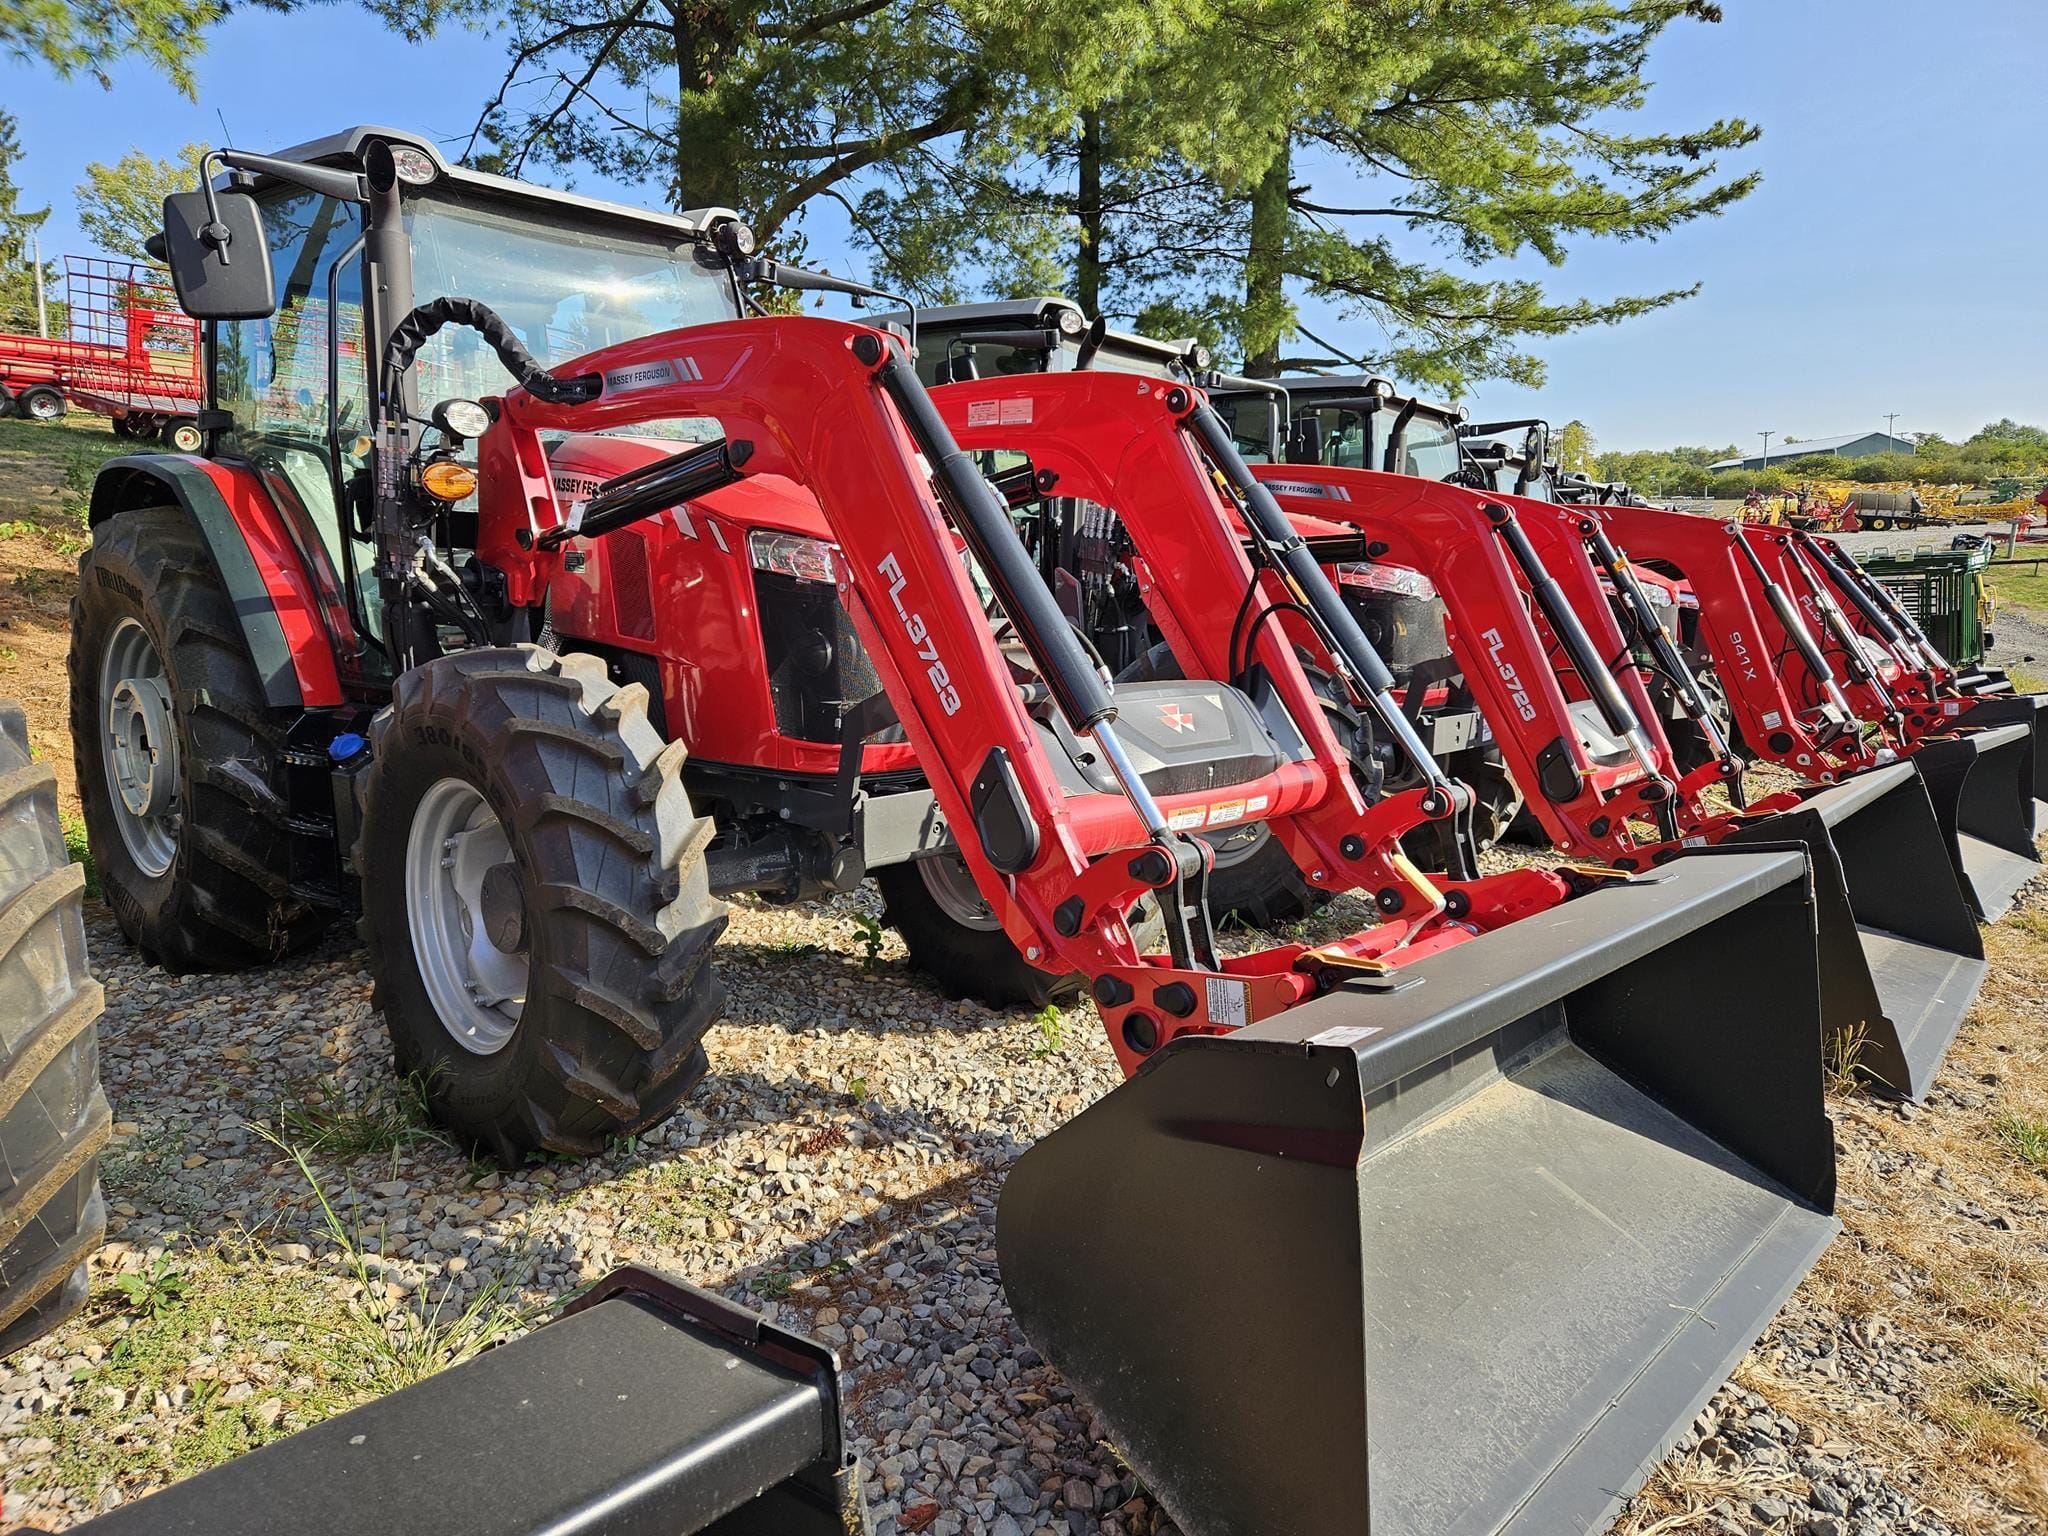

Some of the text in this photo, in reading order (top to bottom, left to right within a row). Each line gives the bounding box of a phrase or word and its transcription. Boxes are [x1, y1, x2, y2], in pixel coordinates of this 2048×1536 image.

[606, 367, 671, 385] MASSEY FERGUSON
[1288, 485, 1323, 495] FERGUSON
[877, 551, 962, 717] FL.3723
[1730, 631, 1757, 681] 941 X
[1481, 627, 1537, 722] FL.3723
